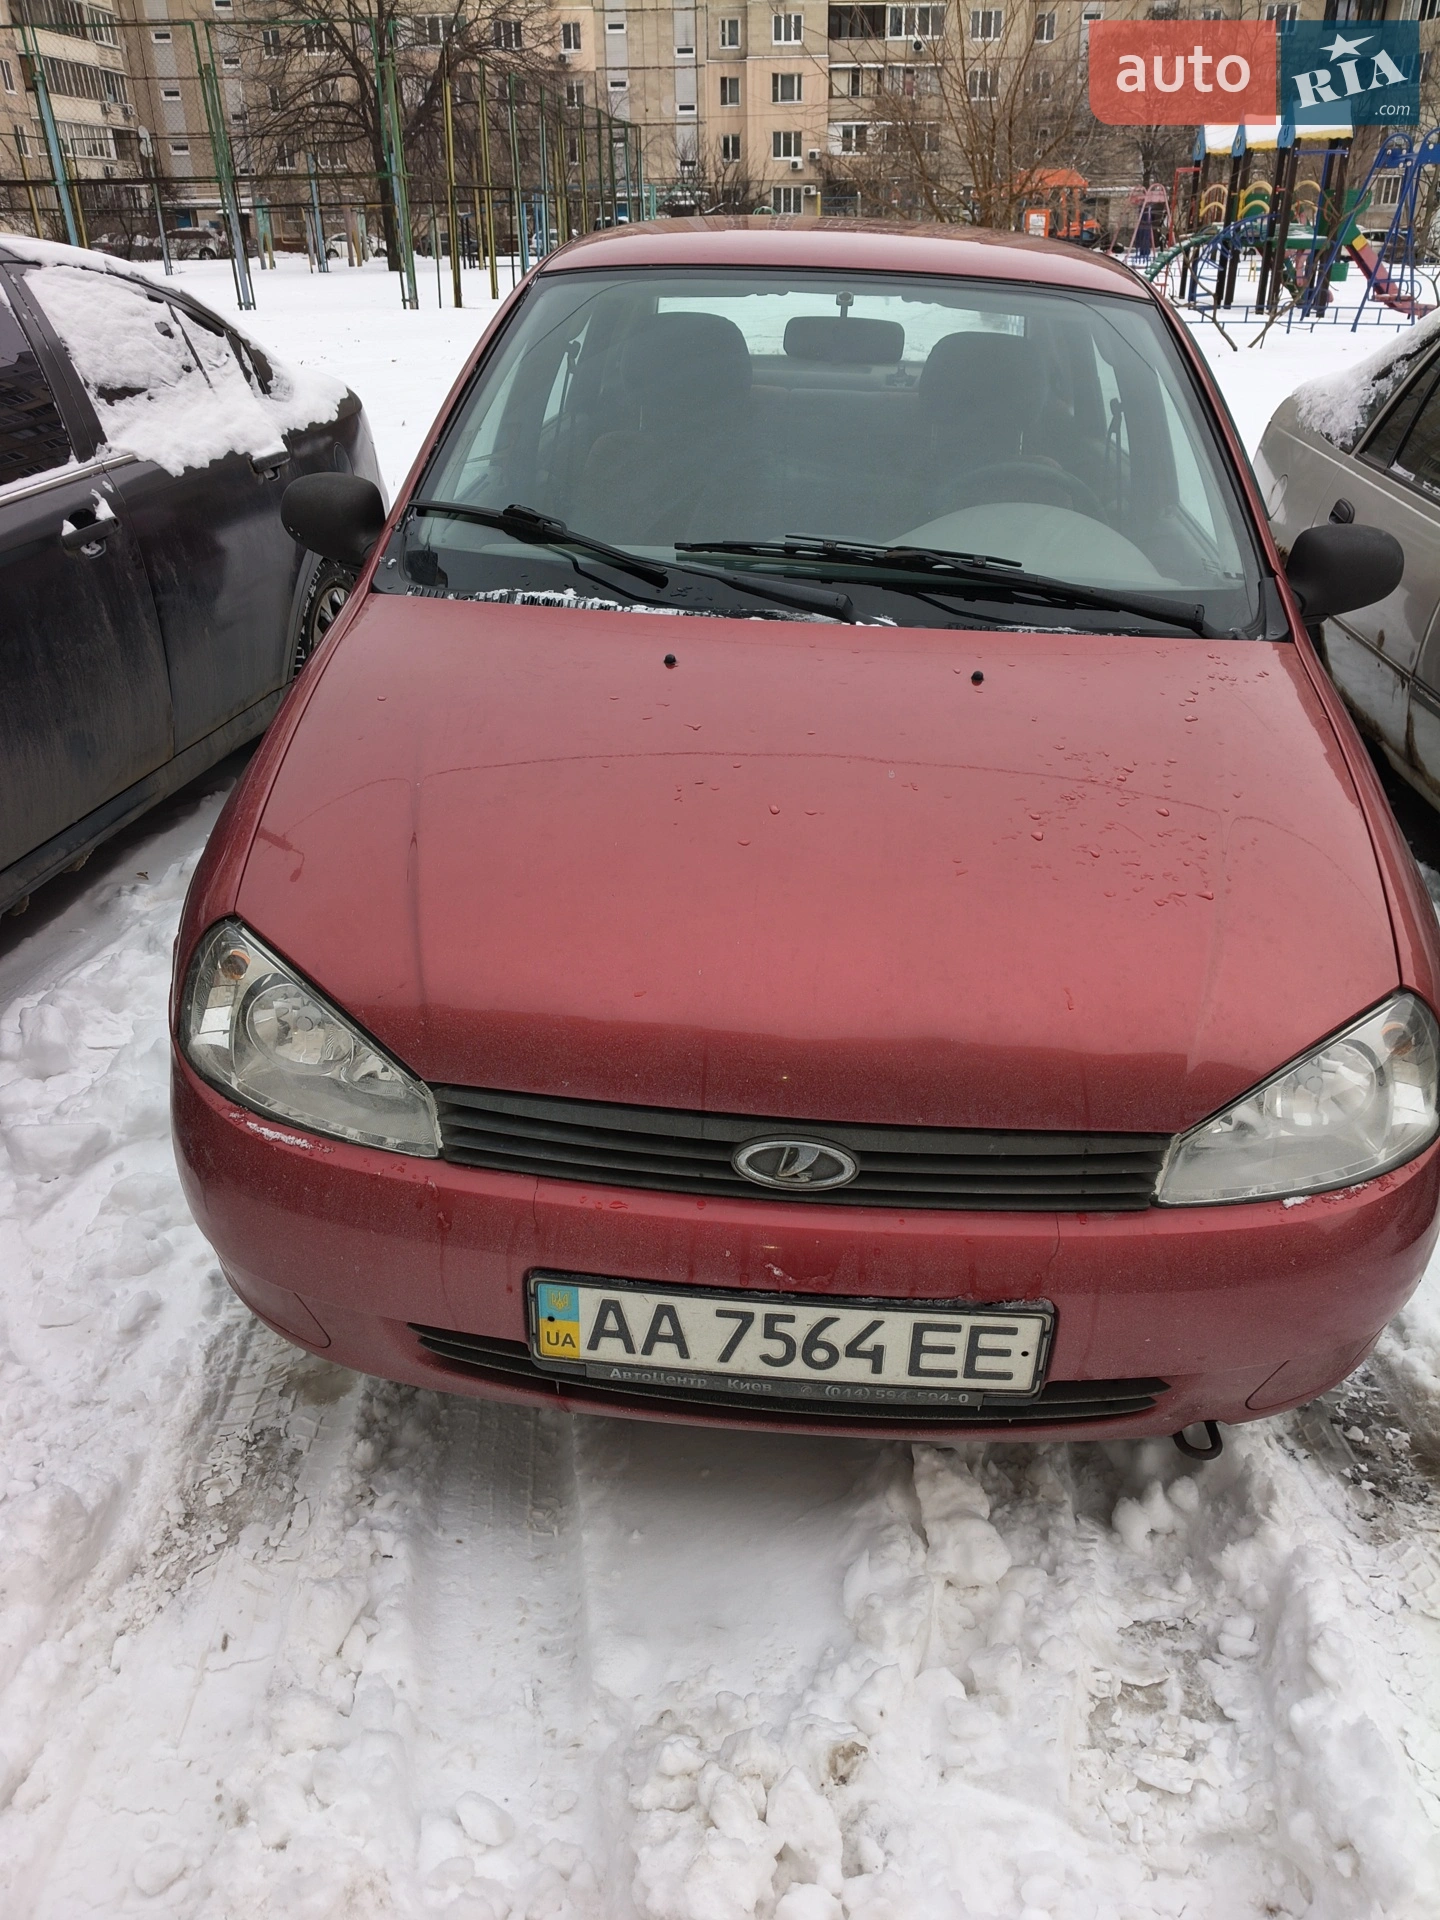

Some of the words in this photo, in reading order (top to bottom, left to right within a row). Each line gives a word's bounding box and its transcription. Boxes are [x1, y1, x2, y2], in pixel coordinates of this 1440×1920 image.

[546, 1330, 576, 1348] UA
[586, 1298, 691, 1359] AA
[714, 1309, 885, 1375] 7564
[908, 1321, 1018, 1381] EE
[727, 1378, 773, 1392] Киев
